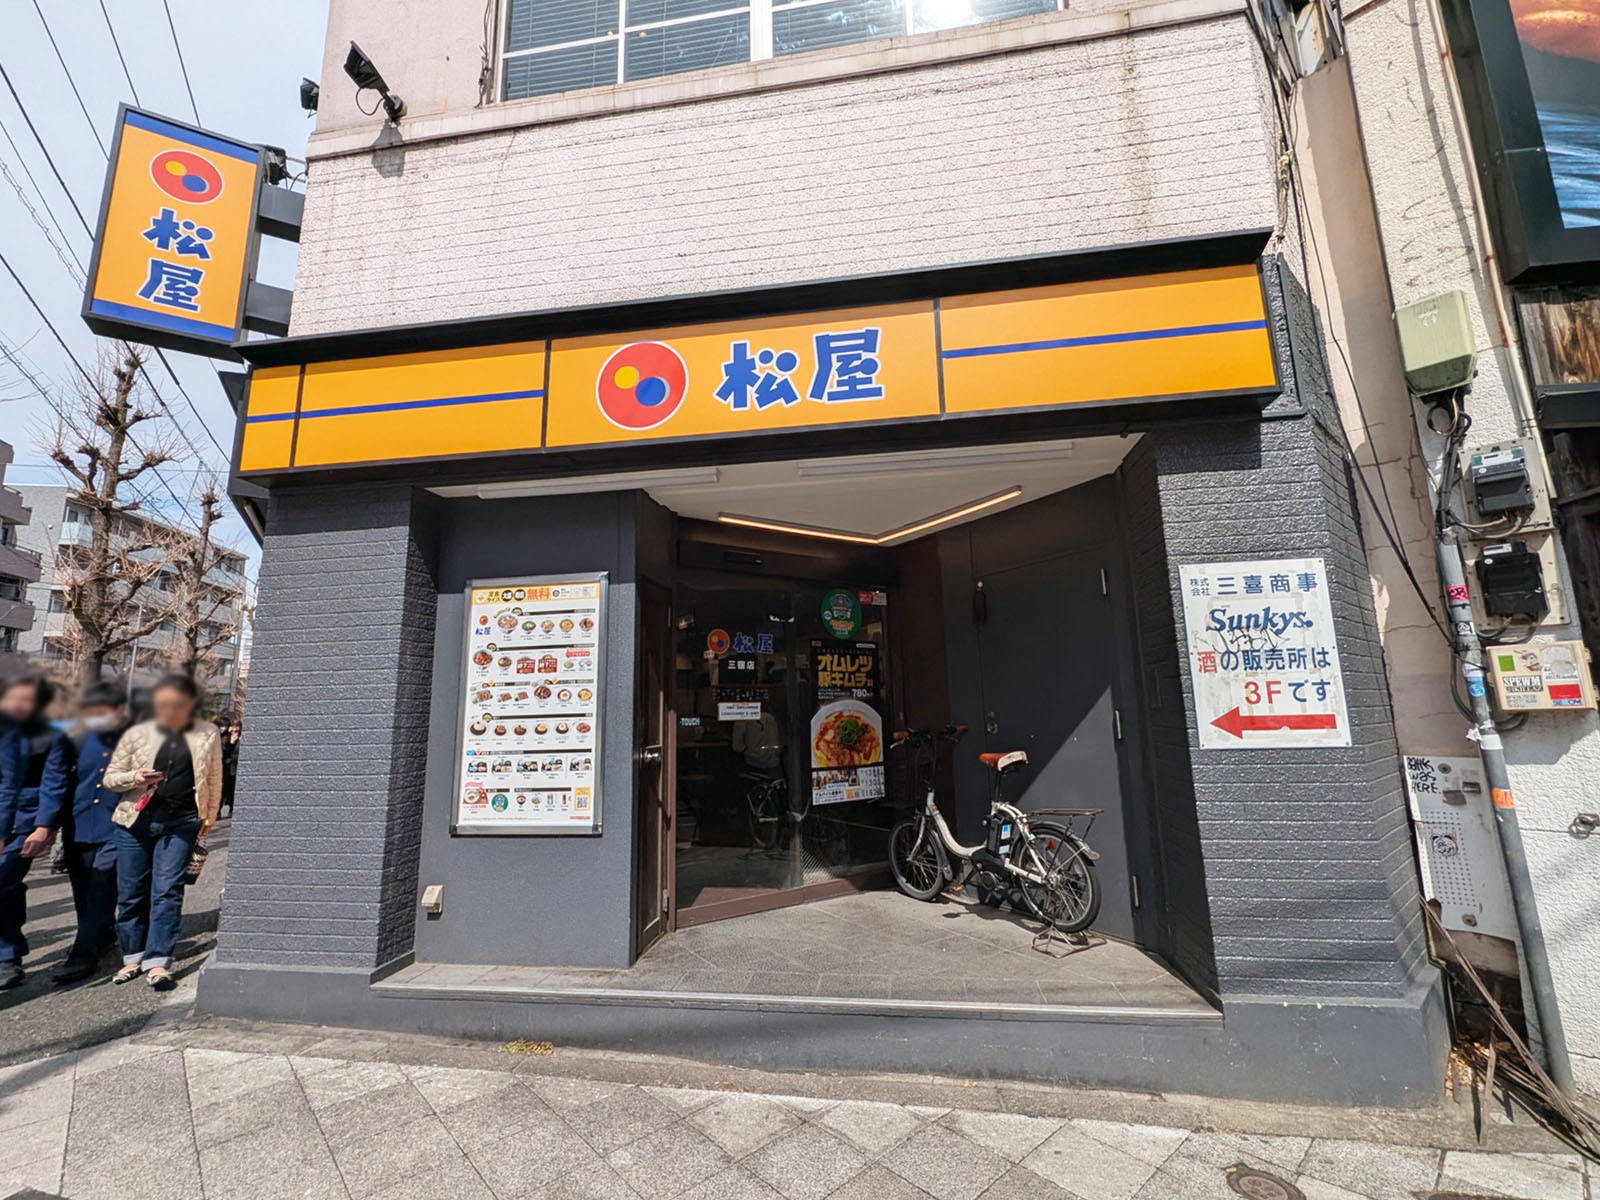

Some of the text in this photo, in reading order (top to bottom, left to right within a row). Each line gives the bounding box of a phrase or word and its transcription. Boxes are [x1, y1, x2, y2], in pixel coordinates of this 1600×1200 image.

[138, 207, 214, 312] 松屋
[713, 327, 884, 411] 松屋
[527, 588, 550, 600] 無料
[1217, 572, 1318, 595] 三喜商事
[733, 632, 774, 654] 松屋
[727, 660, 755, 670] 三宿店
[817, 654, 873, 672] オムレツ
[1197, 647, 1331, 674] 酒の販売所は
